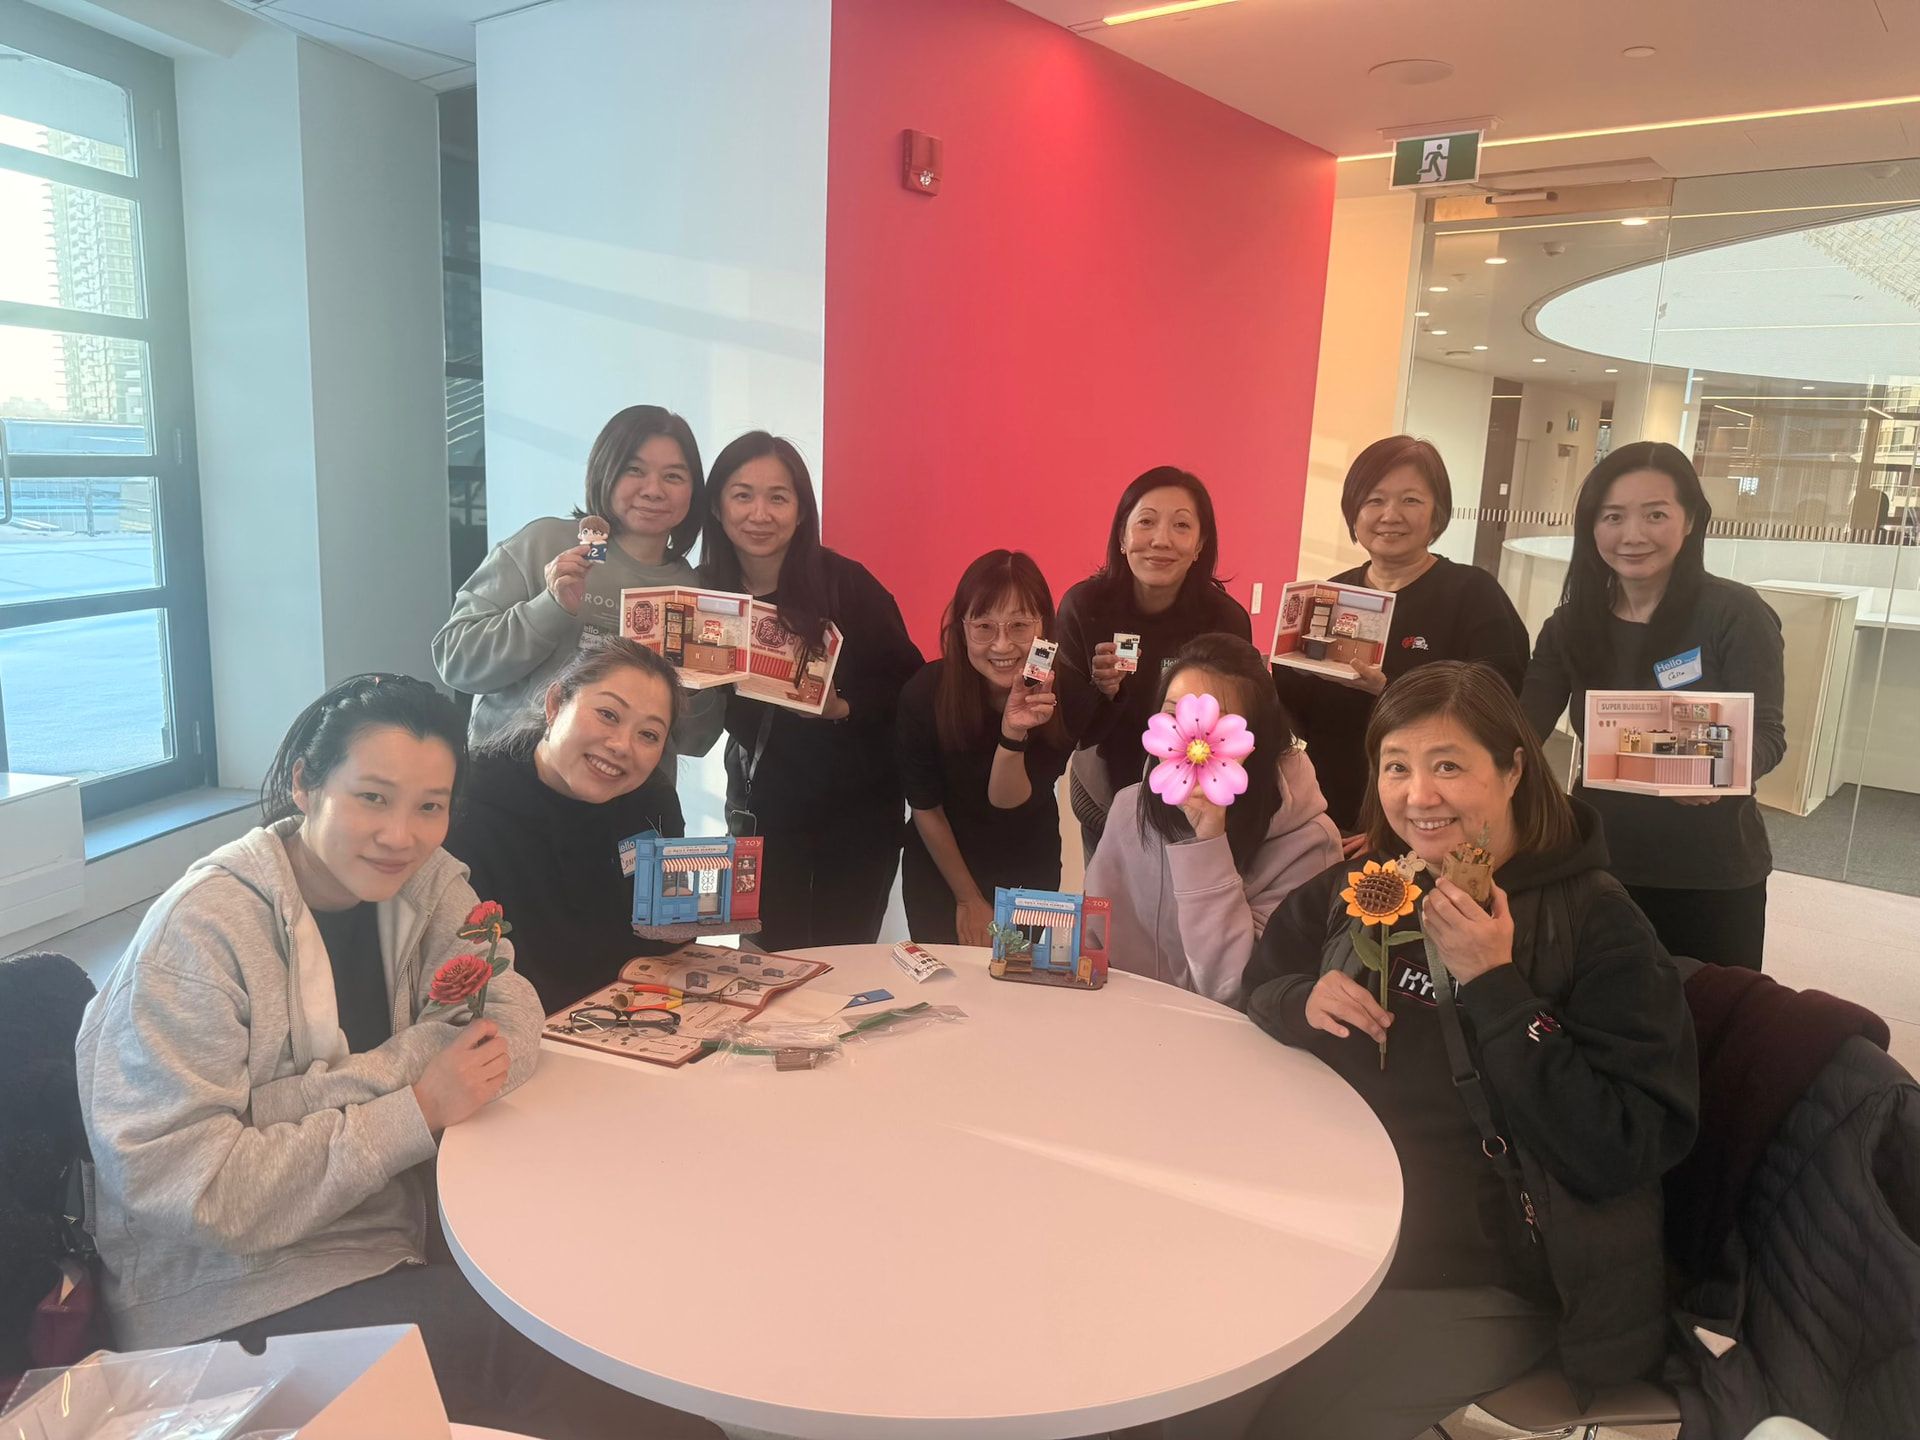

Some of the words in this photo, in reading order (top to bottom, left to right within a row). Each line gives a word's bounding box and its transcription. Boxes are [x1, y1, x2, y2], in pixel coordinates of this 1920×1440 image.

[580, 593, 618, 608] ROO
[584, 625, 599, 635] ello
[1656, 659, 1682, 673] Hello
